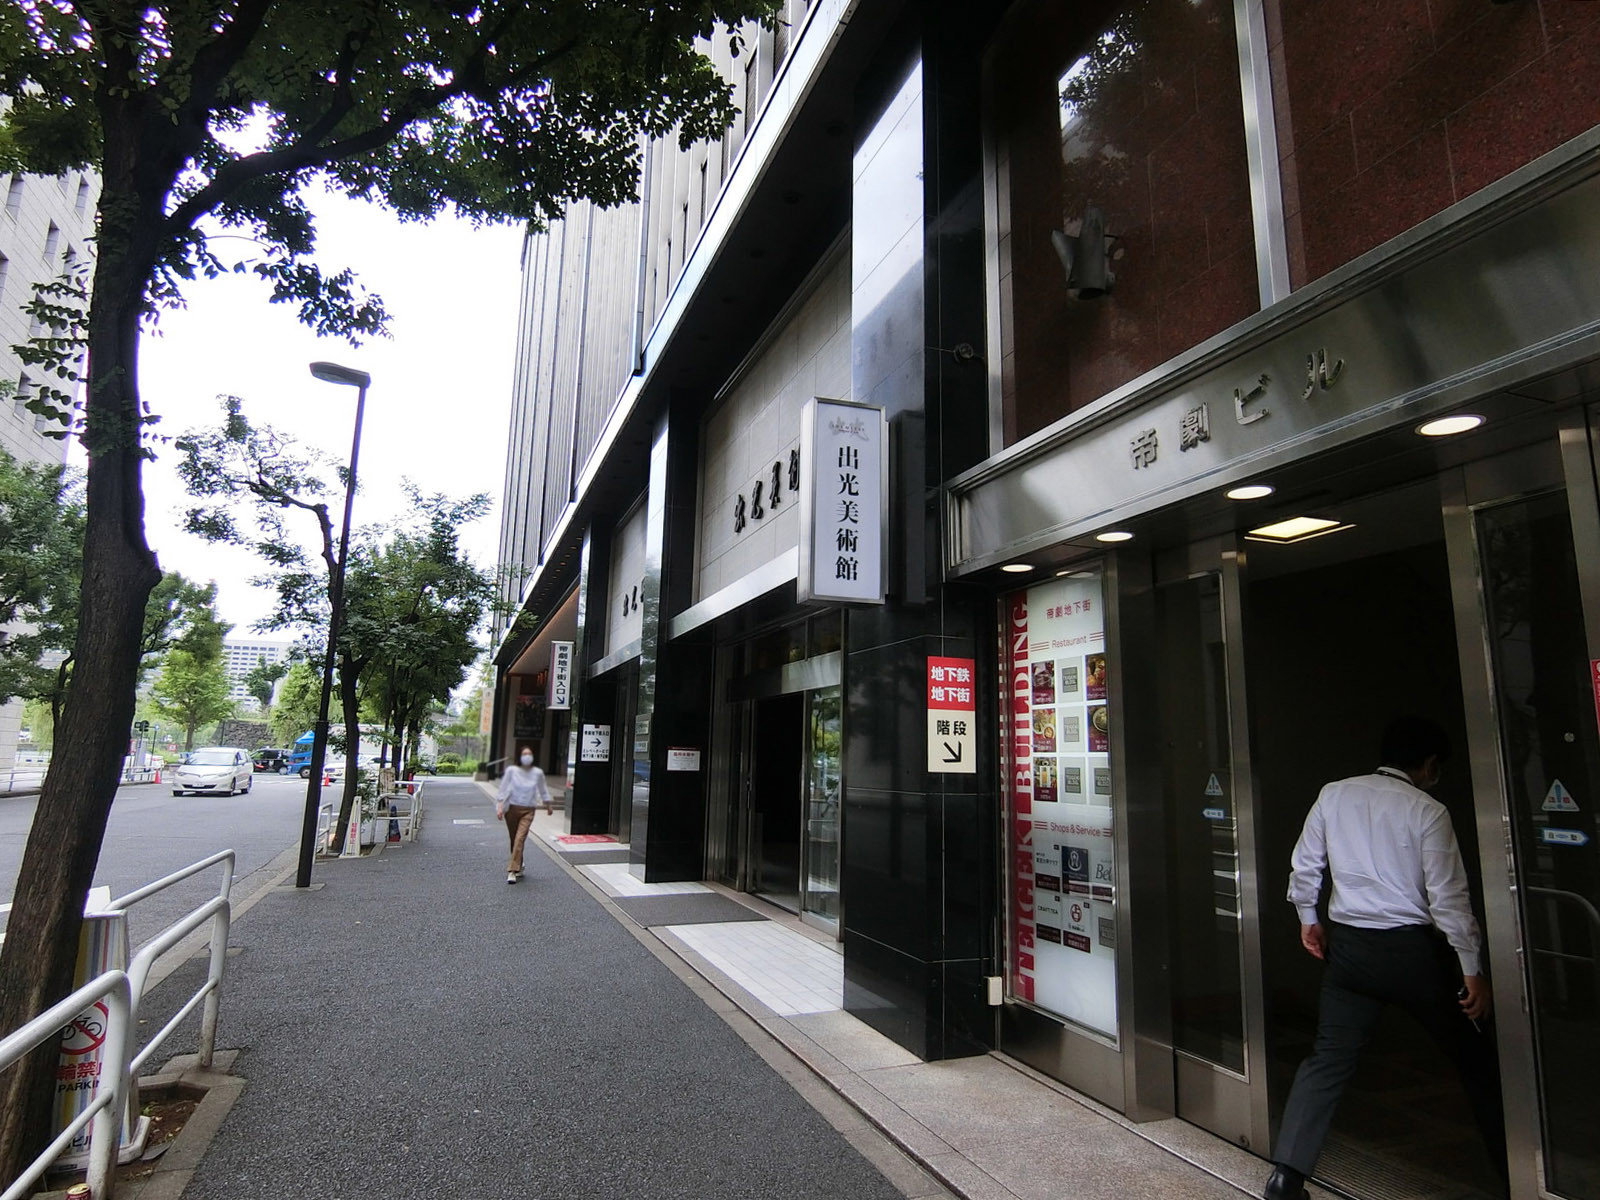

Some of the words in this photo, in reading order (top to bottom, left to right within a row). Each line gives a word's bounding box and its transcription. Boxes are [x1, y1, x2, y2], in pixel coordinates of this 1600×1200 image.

[1130, 348, 1345, 470] 帝劇ビル
[835, 445, 860, 582] 出光美術館
[1046, 598, 1091, 619] 帝劇地下街
[1051, 635, 1087, 648] Restaurant
[931, 665, 971, 683] 地下鉄
[931, 686, 971, 703] 地下街
[1012, 603, 1032, 794] BUILDING
[936, 719, 968, 736] 階段
[1016, 812, 1035, 985] TEIGEKI
